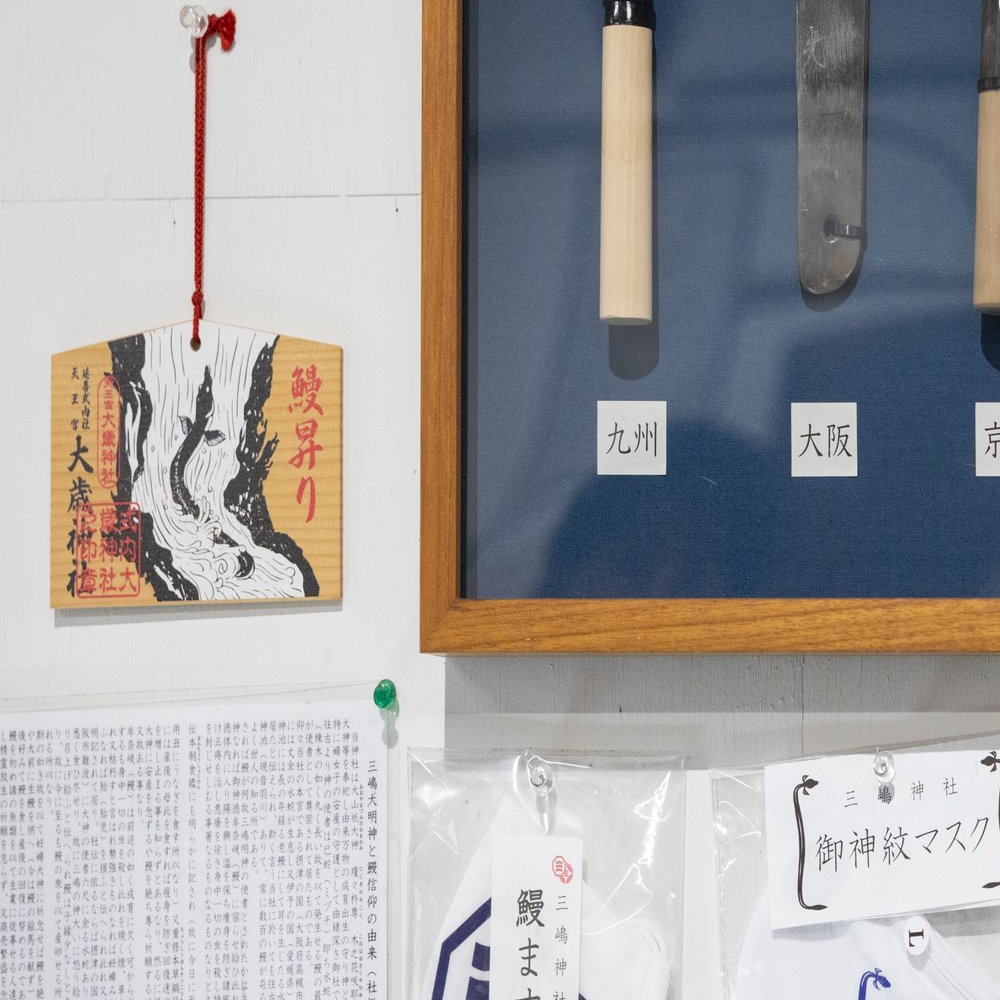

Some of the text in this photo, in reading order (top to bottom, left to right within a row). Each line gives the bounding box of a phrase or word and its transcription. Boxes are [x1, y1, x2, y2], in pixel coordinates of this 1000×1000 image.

[288, 364, 324, 523] 鰻昇り
[605, 421, 658, 457] 九州
[798, 422, 853, 458] 大阪
[844, 776, 959, 808] 三嶋神社
[815, 816, 990, 873] 御神紋マスク
[515, 889, 546, 1000] 鰻ま
[908, 928, 925, 947] L
